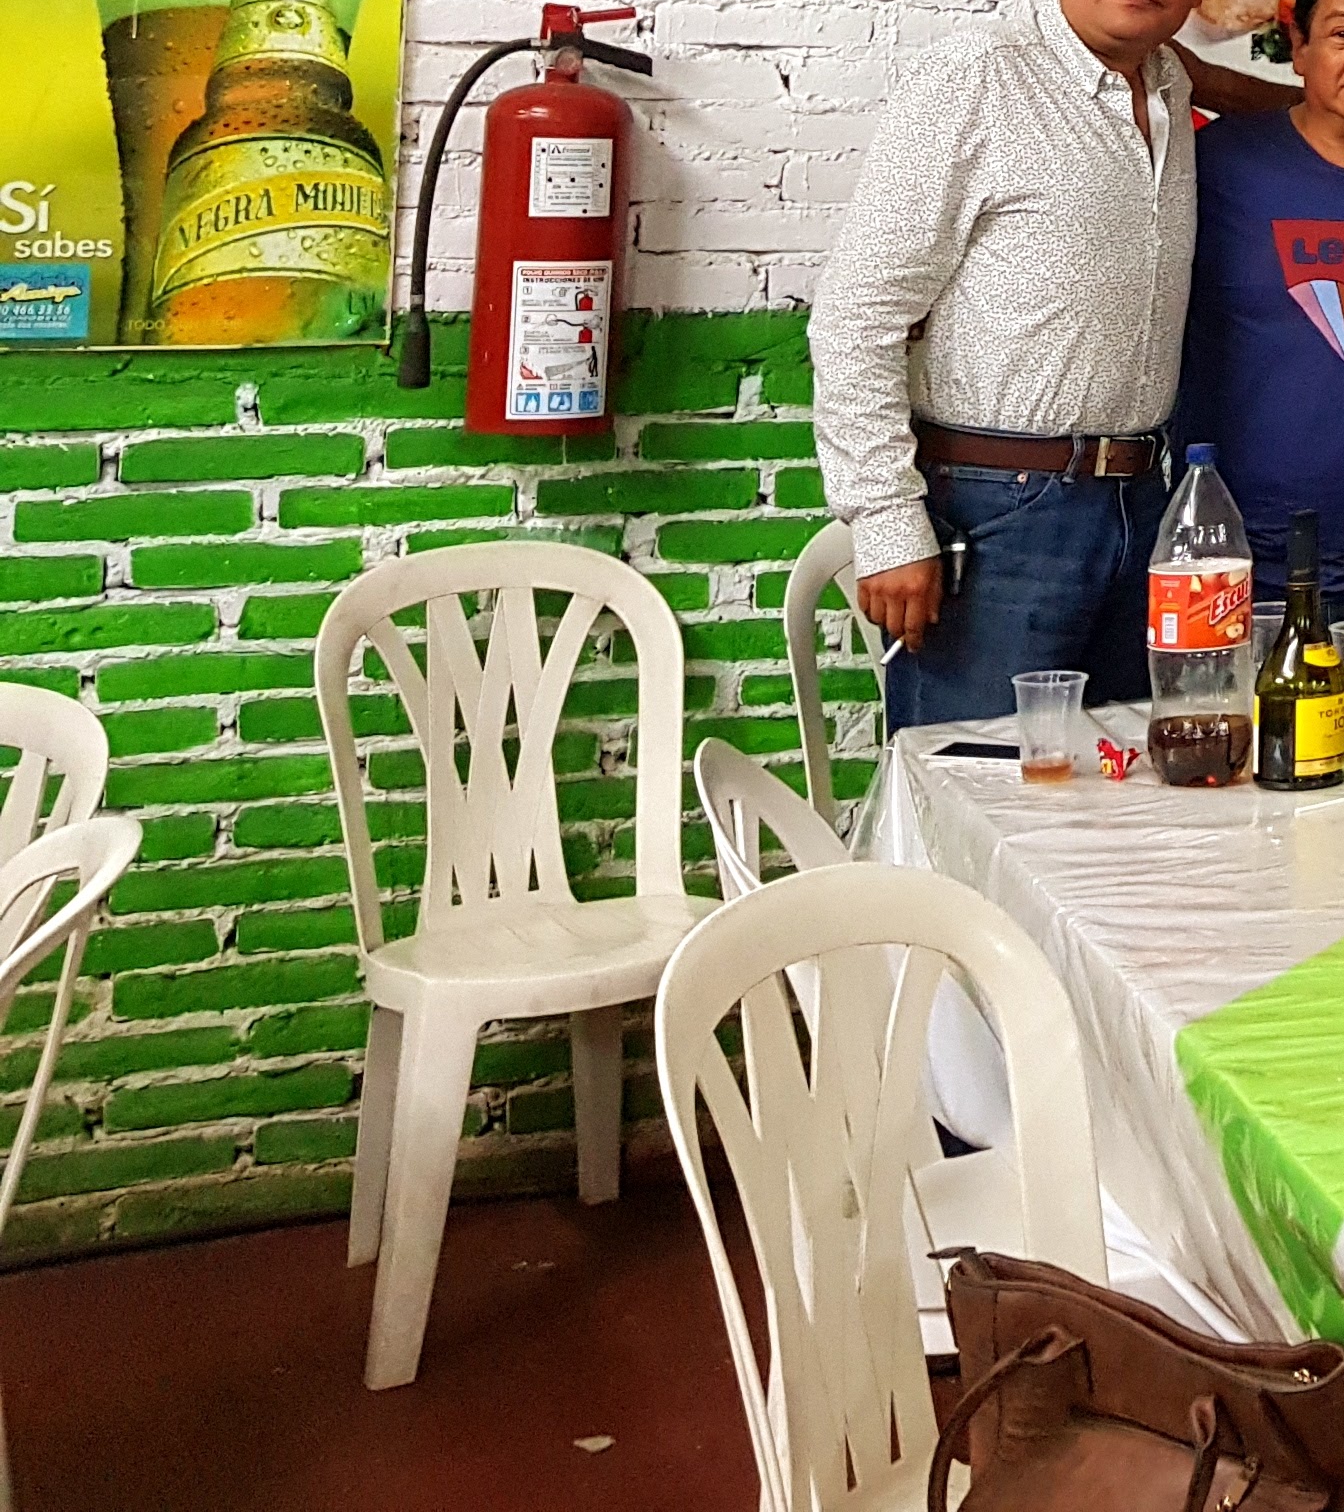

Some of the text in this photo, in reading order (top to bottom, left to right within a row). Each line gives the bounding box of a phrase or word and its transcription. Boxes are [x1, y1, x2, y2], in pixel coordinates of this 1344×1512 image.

[0, 180, 56, 234] Sí
[177, 188, 276, 249] NEGRA
[14, 230, 113, 258] sabes
[127, 319, 166, 331] TODO
